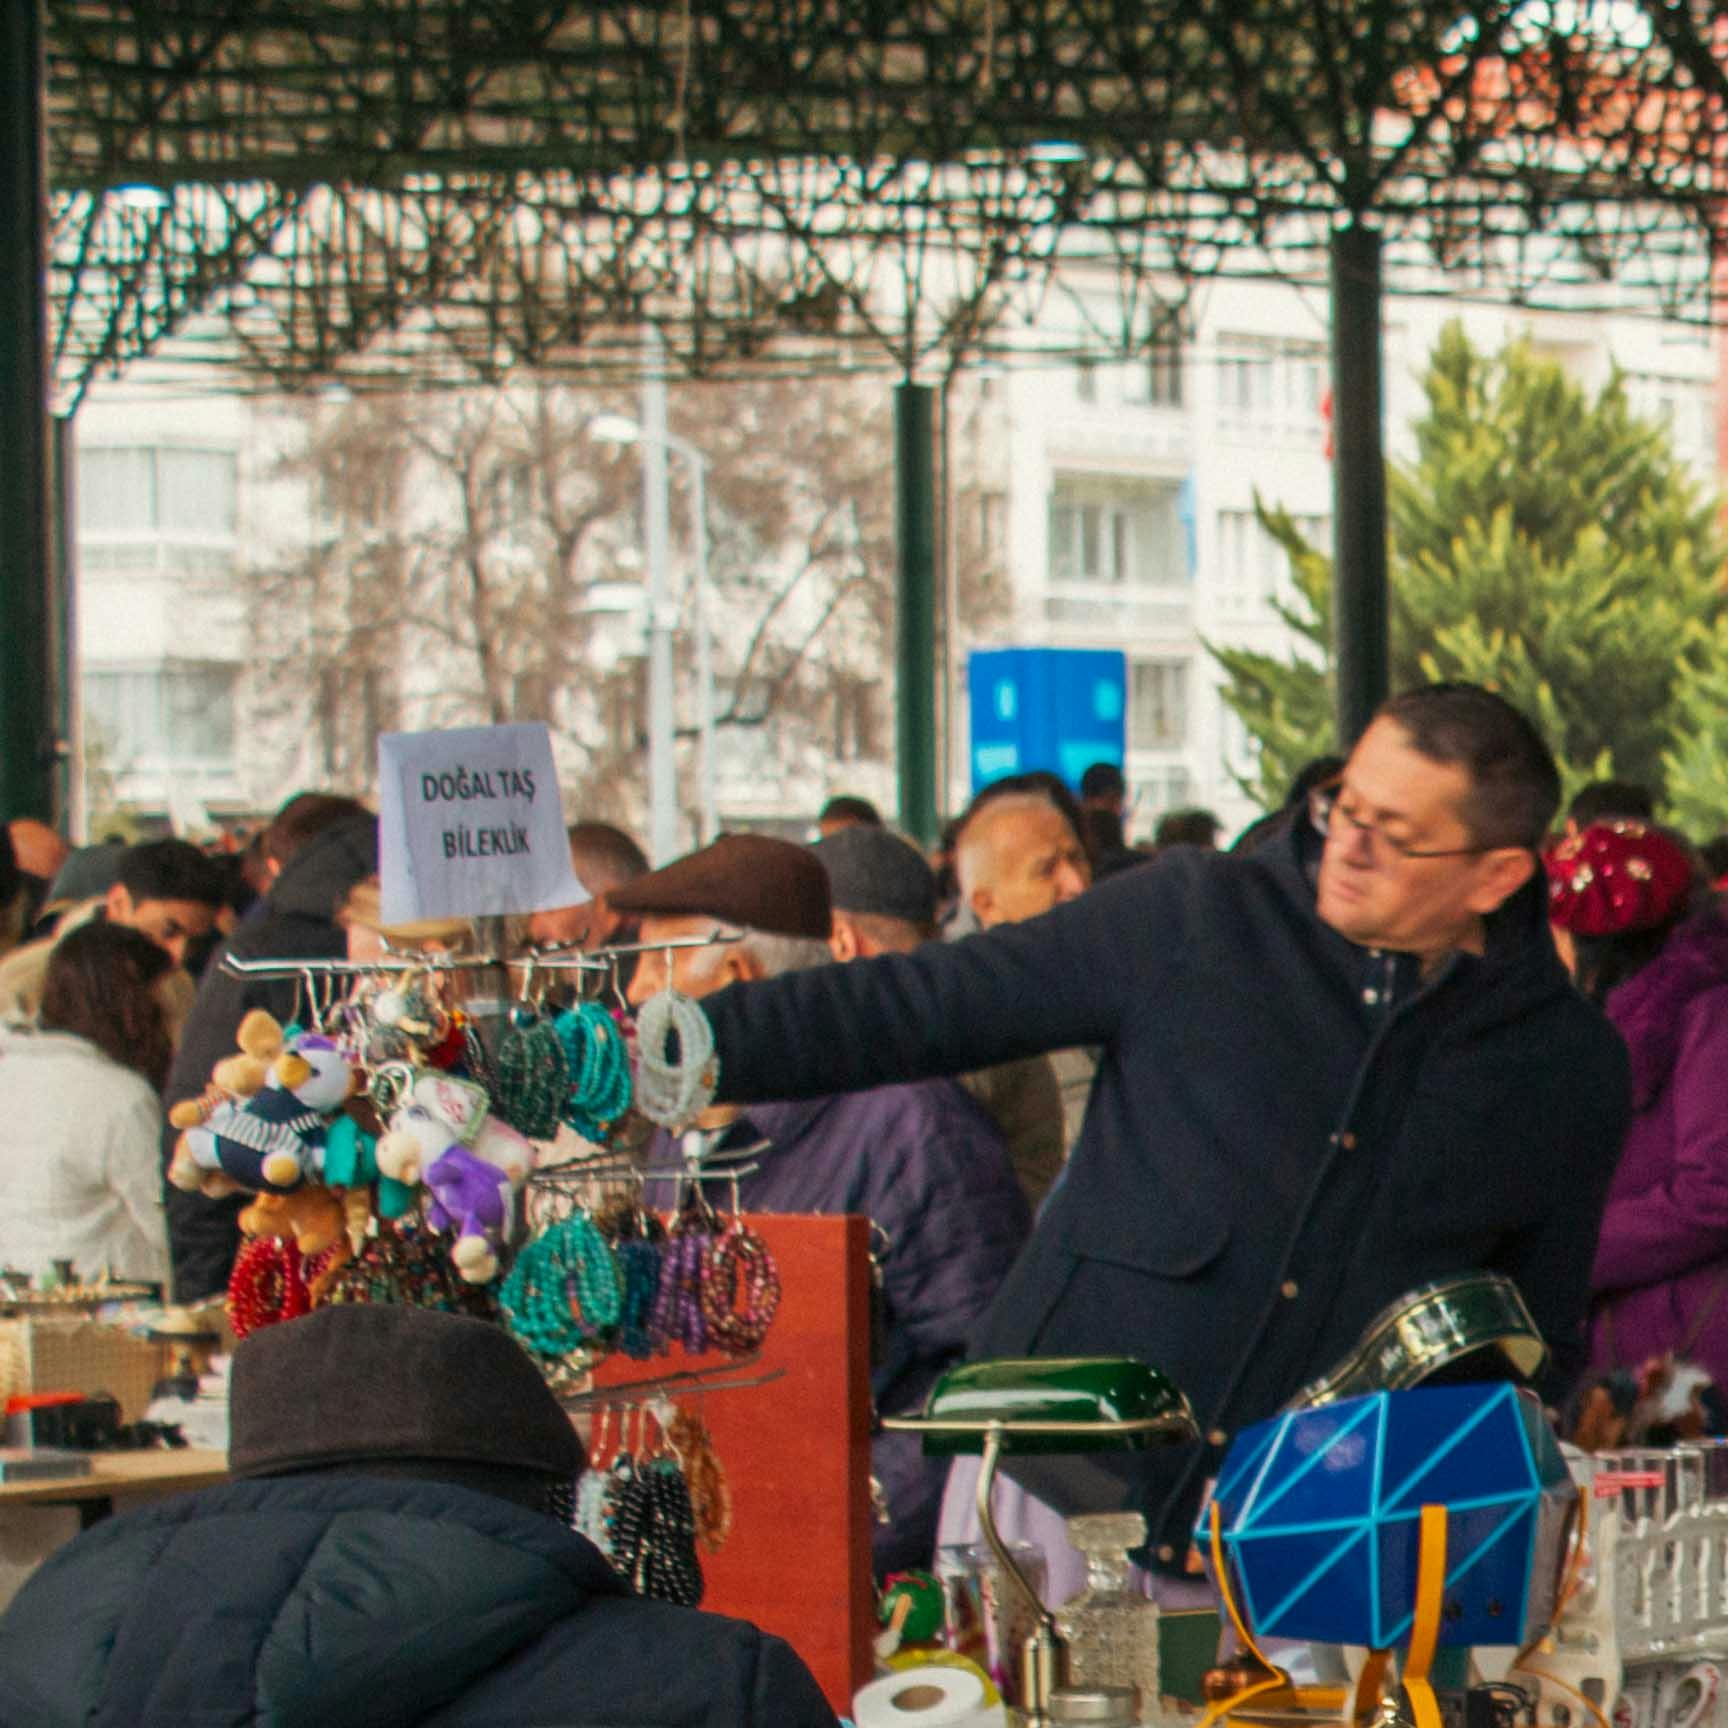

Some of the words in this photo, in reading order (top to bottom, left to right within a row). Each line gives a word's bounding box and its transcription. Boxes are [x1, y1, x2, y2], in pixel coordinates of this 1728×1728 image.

[421, 764, 496, 802] DOĞAL
[498, 768, 536, 804] TAŞ
[442, 823, 530, 858] BİLEKLİK
